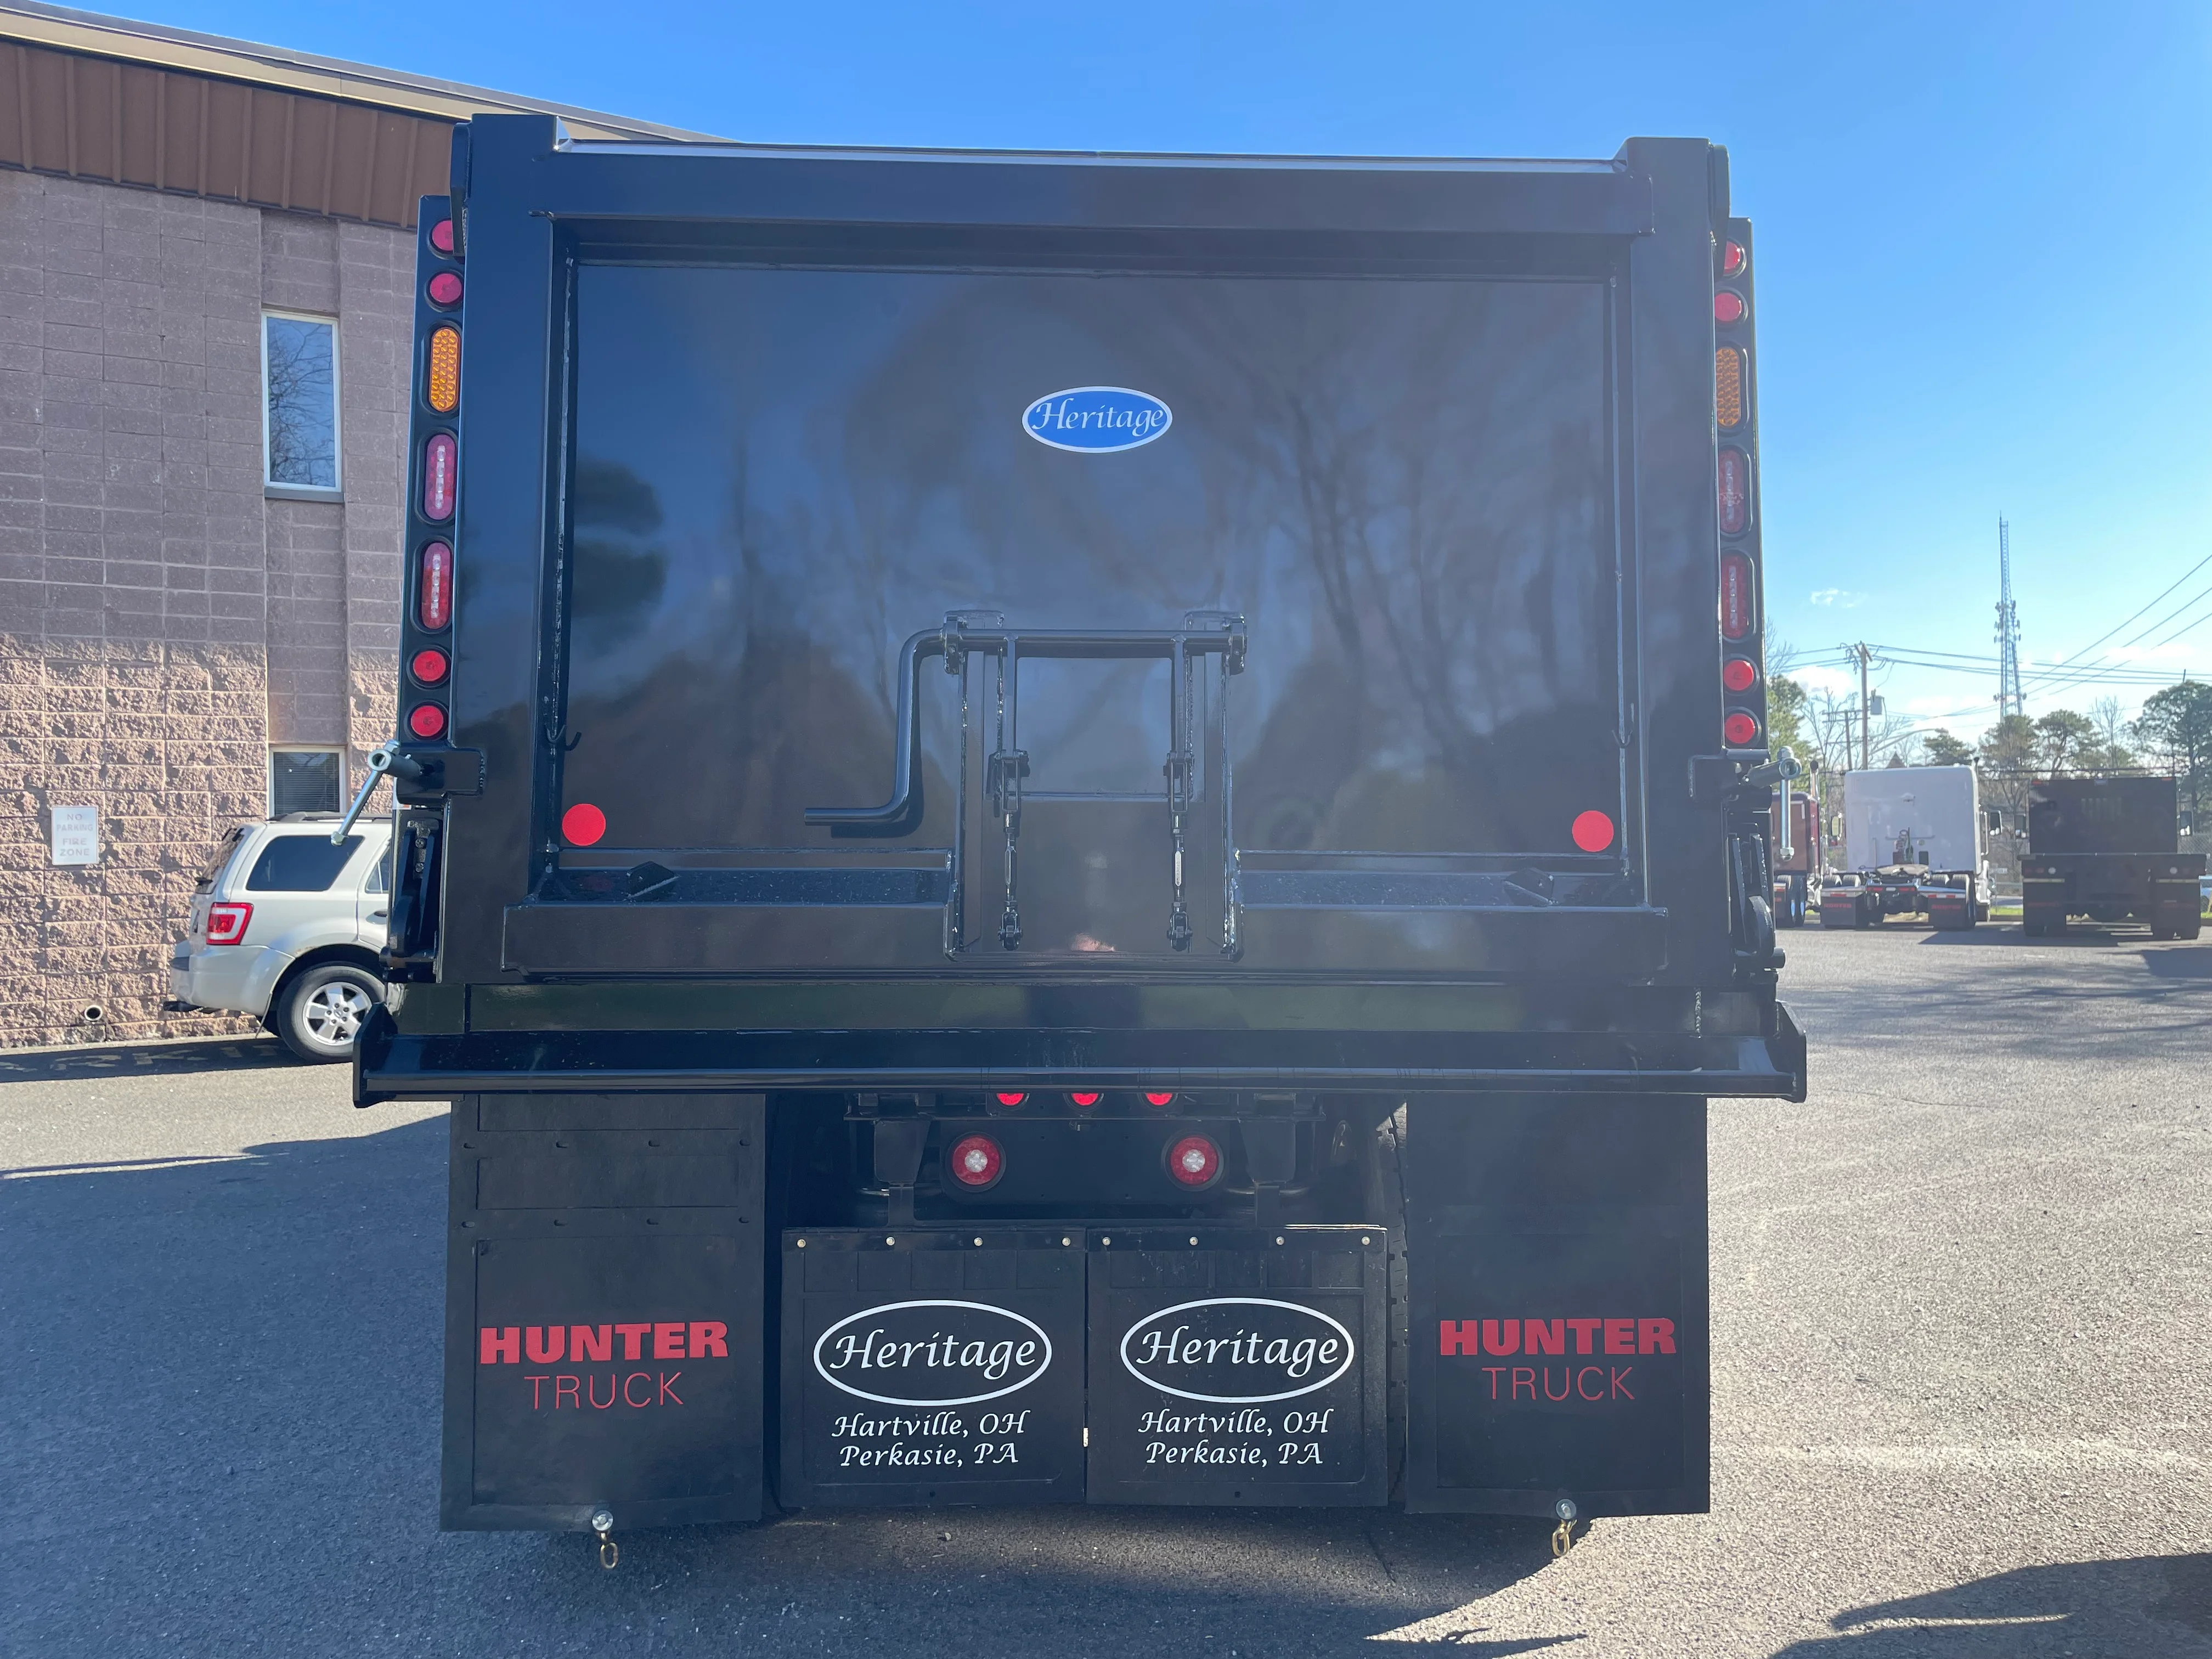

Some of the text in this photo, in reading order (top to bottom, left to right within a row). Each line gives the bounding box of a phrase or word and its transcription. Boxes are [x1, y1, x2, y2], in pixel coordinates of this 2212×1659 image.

[1031, 398, 1164, 437] Heritage
[60, 848, 89, 856] ZONE
[480, 1321, 729, 1364] HUNTER
[829, 1329, 1036, 1380] Heritage
[1136, 1325, 1339, 1378] Heritage
[1440, 1317, 1677, 1356] HUNTER
[524, 1372, 684, 1409] TRUCK
[1482, 1366, 1635, 1401] TRUCK
[831, 1409, 1031, 1438] Hartville, OH
[1137, 1408, 1334, 1437] Hartville, OH
[840, 1442, 1019, 1468] Perkasie, PA
[1145, 1439, 1323, 1468] Perkasie, PA
